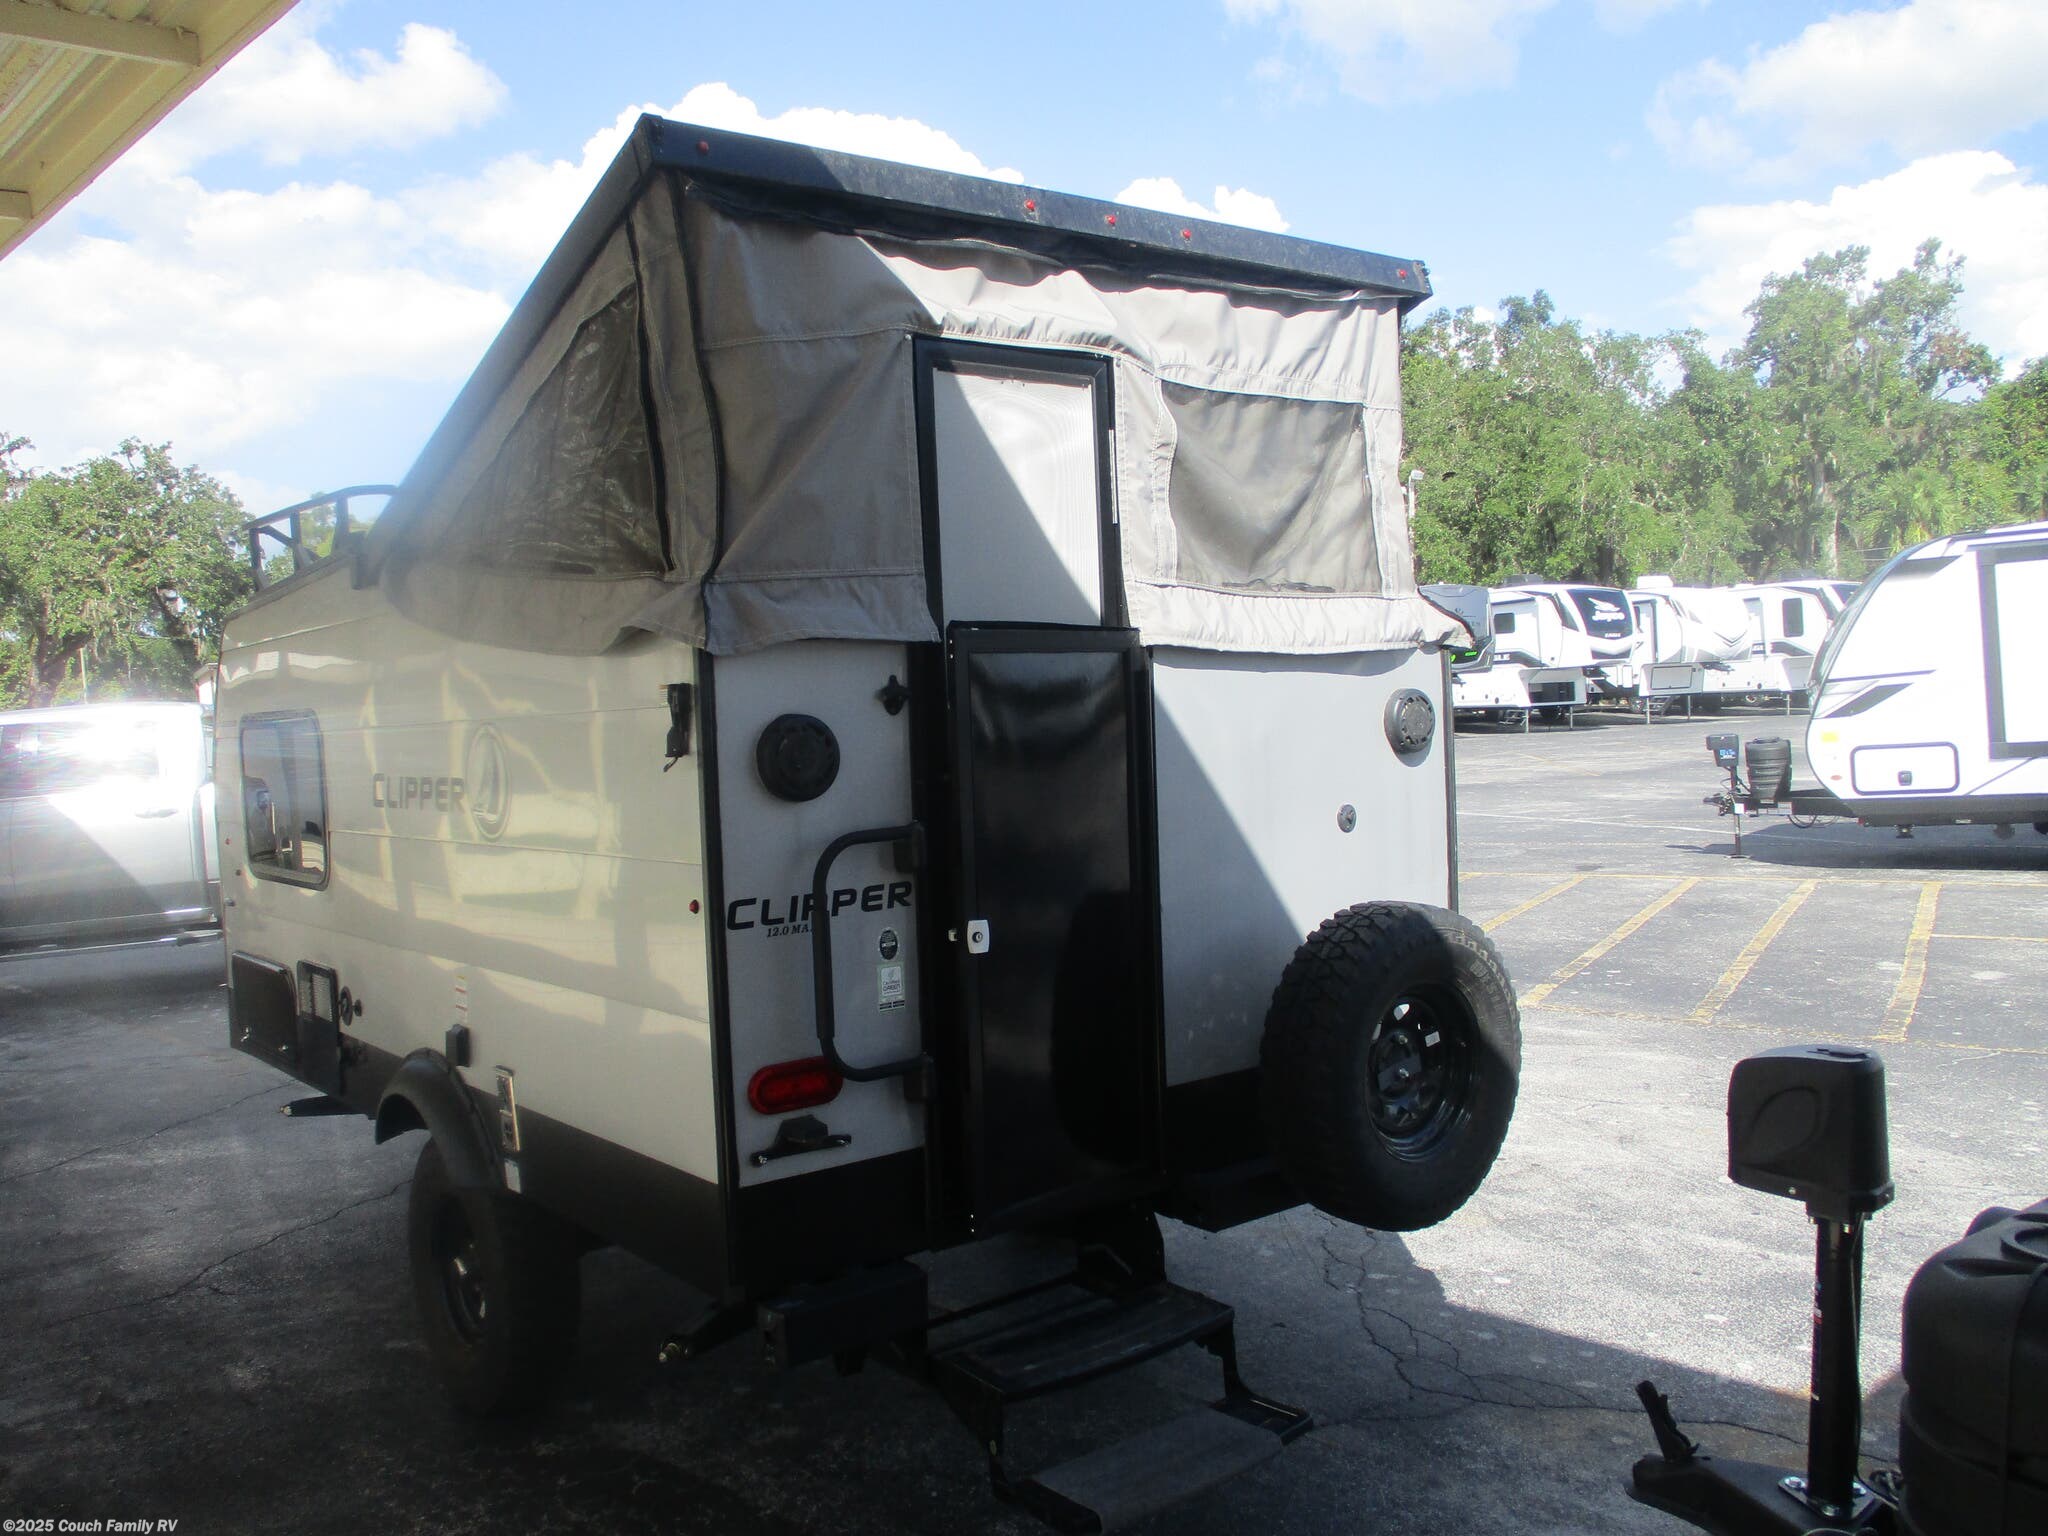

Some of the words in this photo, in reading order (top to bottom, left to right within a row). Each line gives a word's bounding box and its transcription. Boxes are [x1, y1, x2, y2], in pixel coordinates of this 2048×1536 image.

[373, 773, 464, 815] CLIPPER
[767, 926, 789, 938] 12.0
[791, 923, 816, 936] MA
